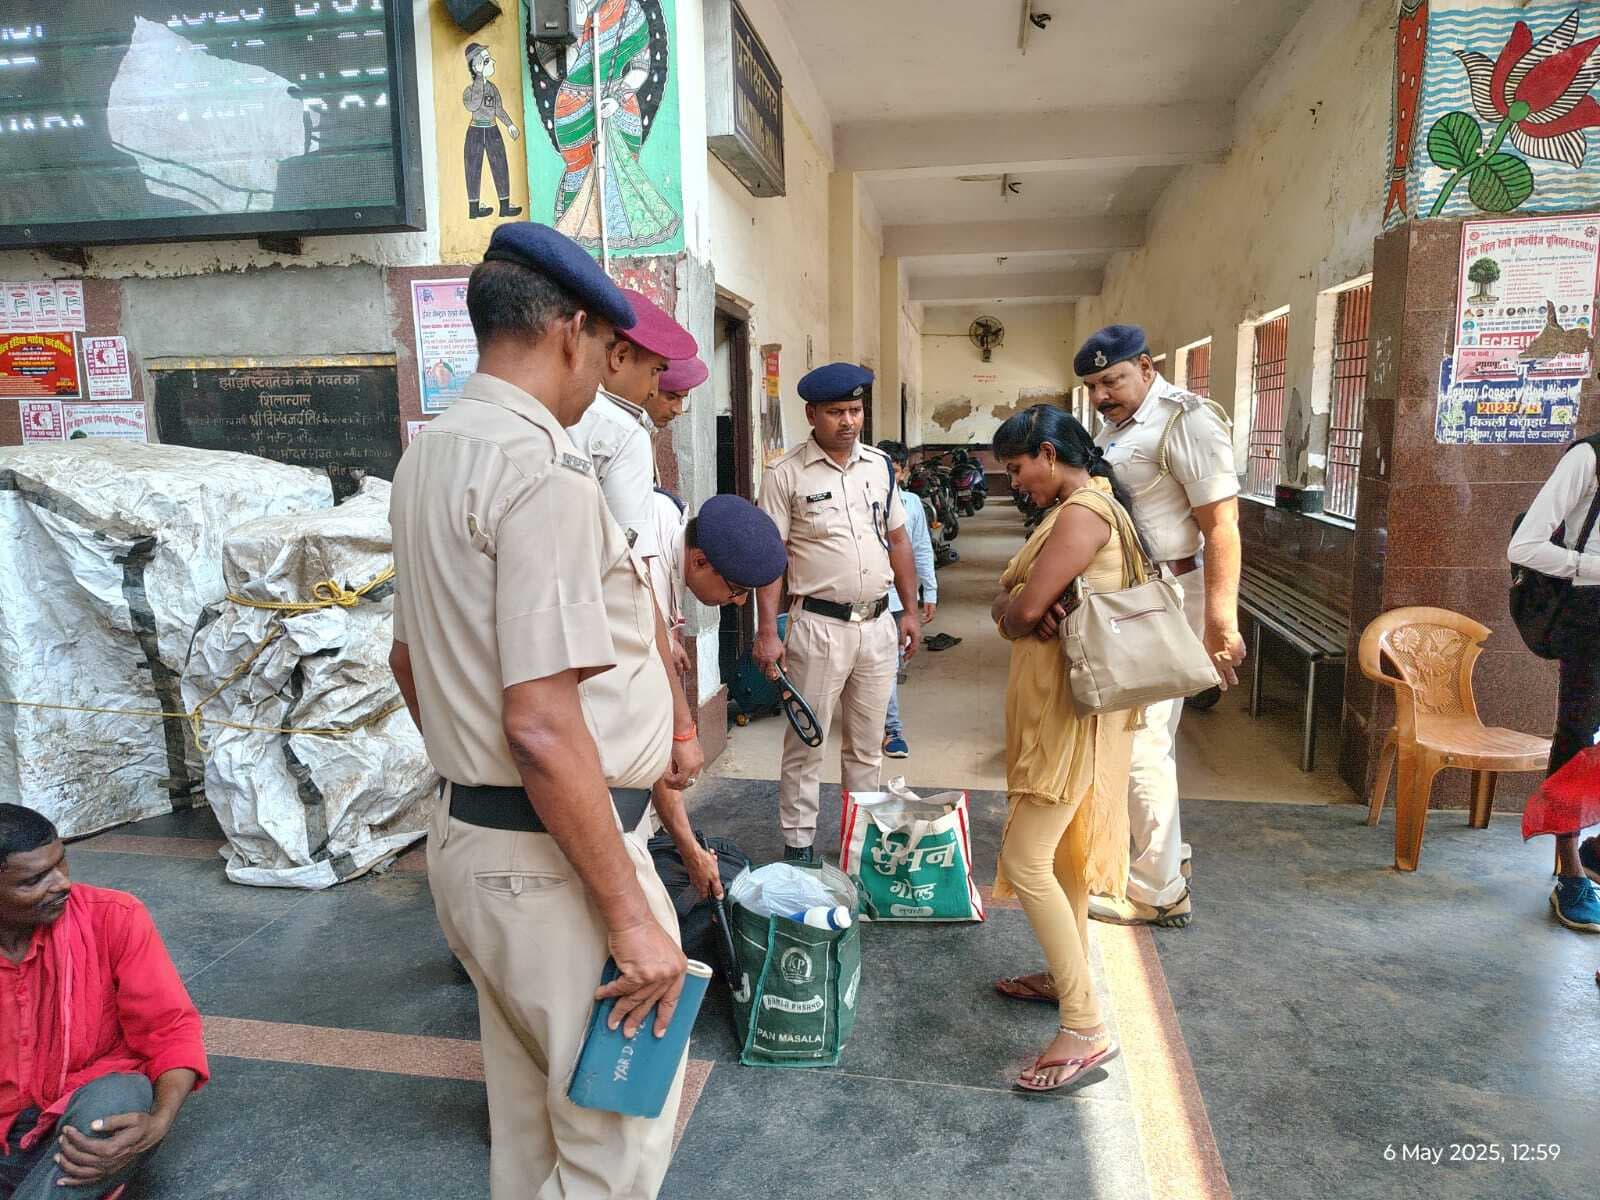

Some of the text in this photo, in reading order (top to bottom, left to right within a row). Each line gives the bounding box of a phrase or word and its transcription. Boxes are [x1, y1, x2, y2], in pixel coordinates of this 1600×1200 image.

[342, 374, 360, 385] का
[1470, 416, 1506, 427] बिजली
[890, 878, 937, 901] गोल्ड
[757, 1028, 822, 1042] PAN MASALA
